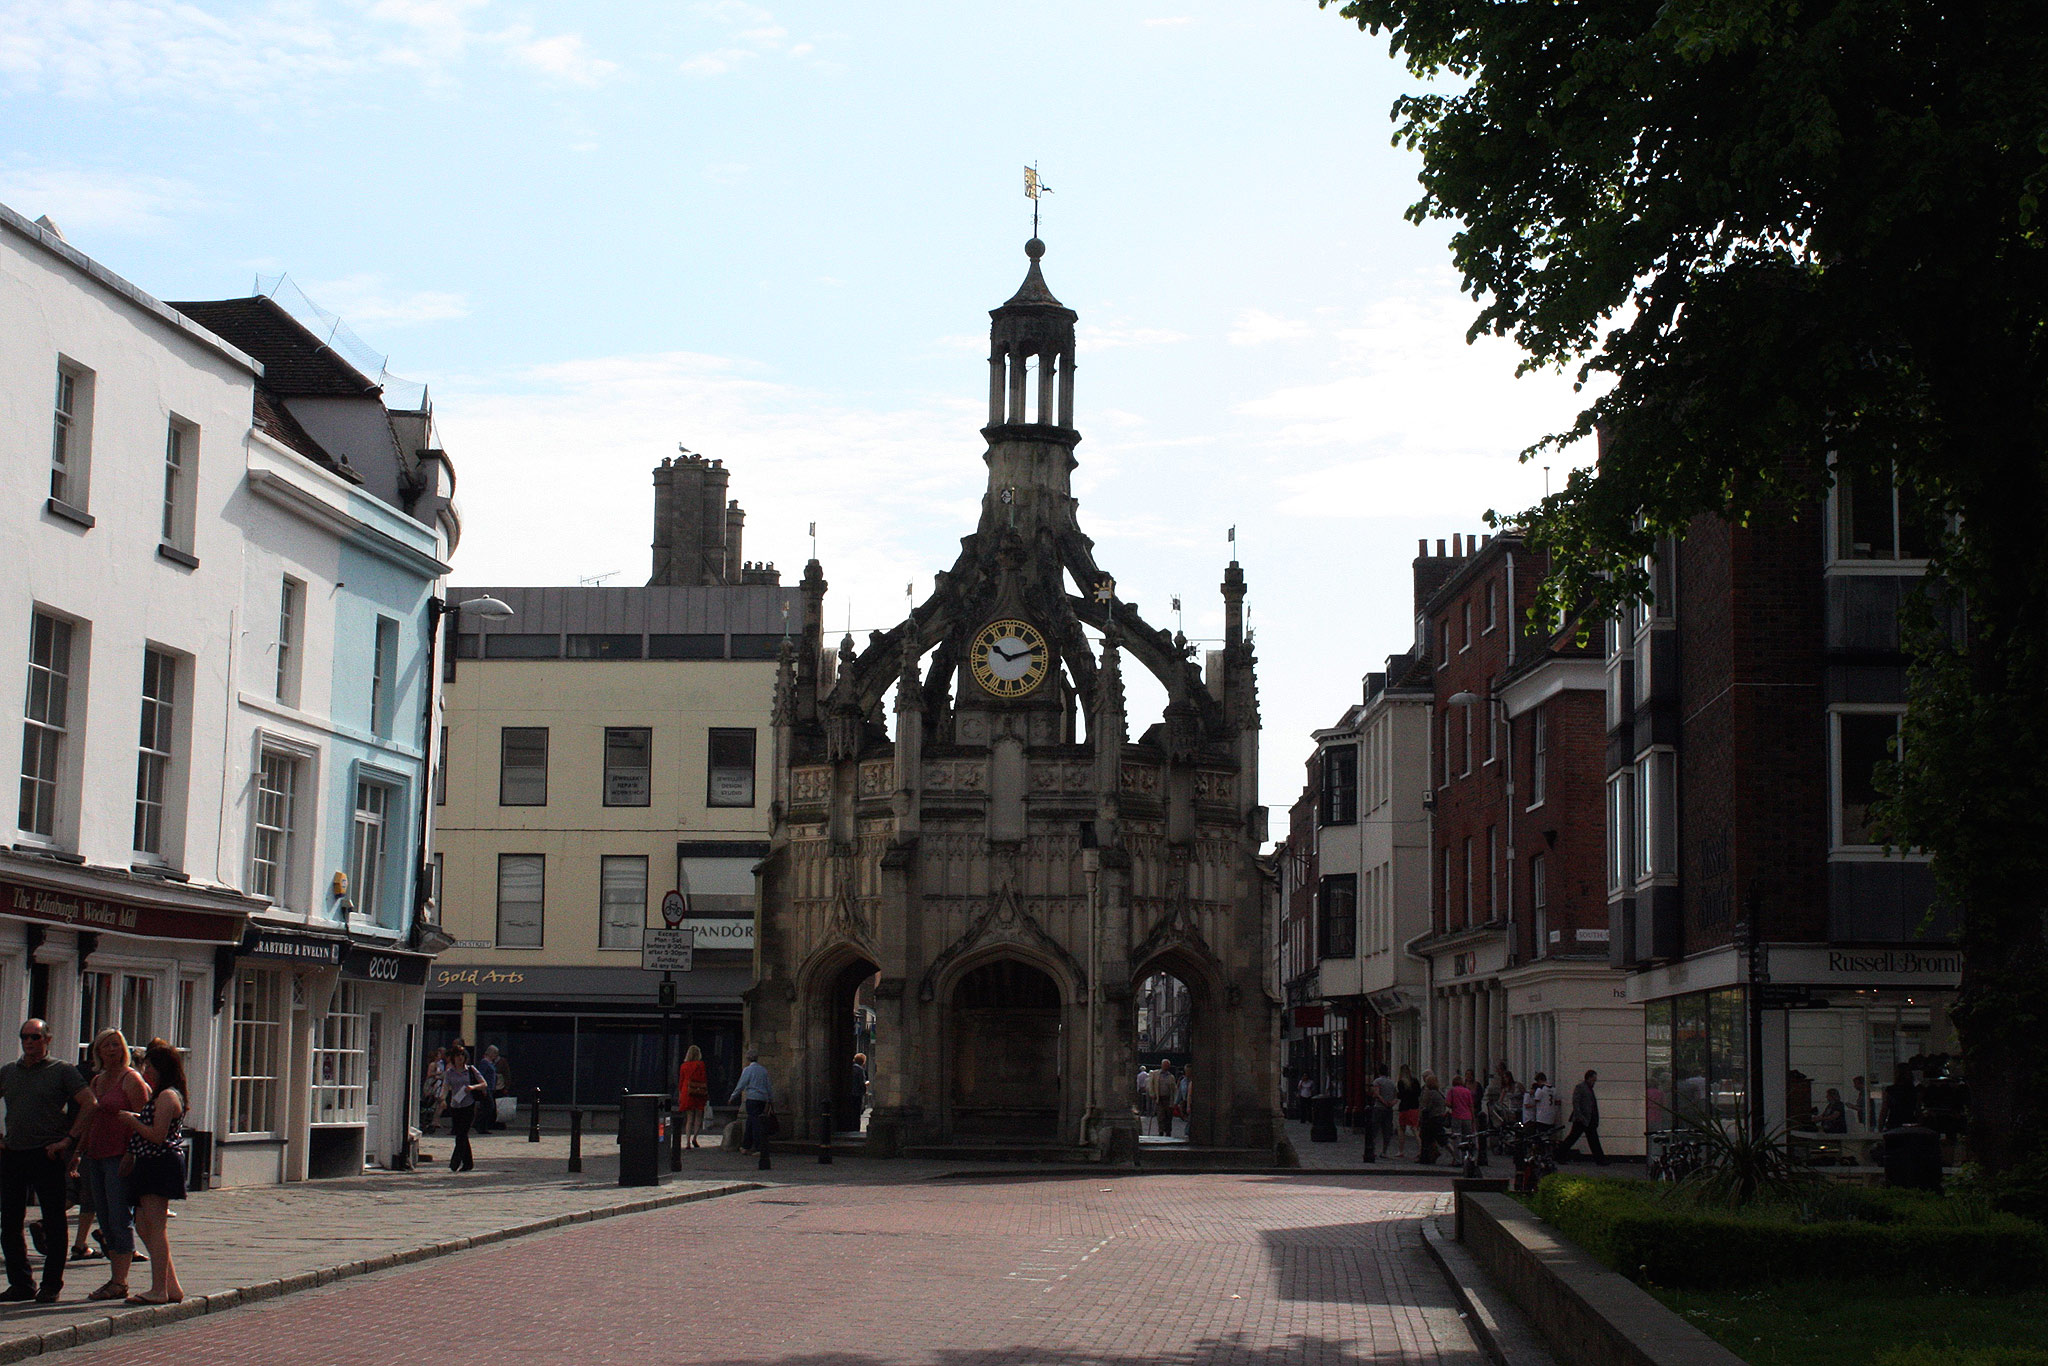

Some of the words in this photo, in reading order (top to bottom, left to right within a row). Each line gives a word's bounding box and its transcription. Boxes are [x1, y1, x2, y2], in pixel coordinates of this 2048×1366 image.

[13, 887, 31, 910] The
[34, 891, 79, 924] Edinburgh
[83, 901, 116, 925] Woollen
[118, 906, 138, 928] Mill
[1579, 931, 1603, 939] SOUTH
[302, 945, 330, 959] EVELYN
[369, 956, 398, 980] ecco
[437, 969, 480, 988] Gold
[481, 969, 524, 983] Arts
